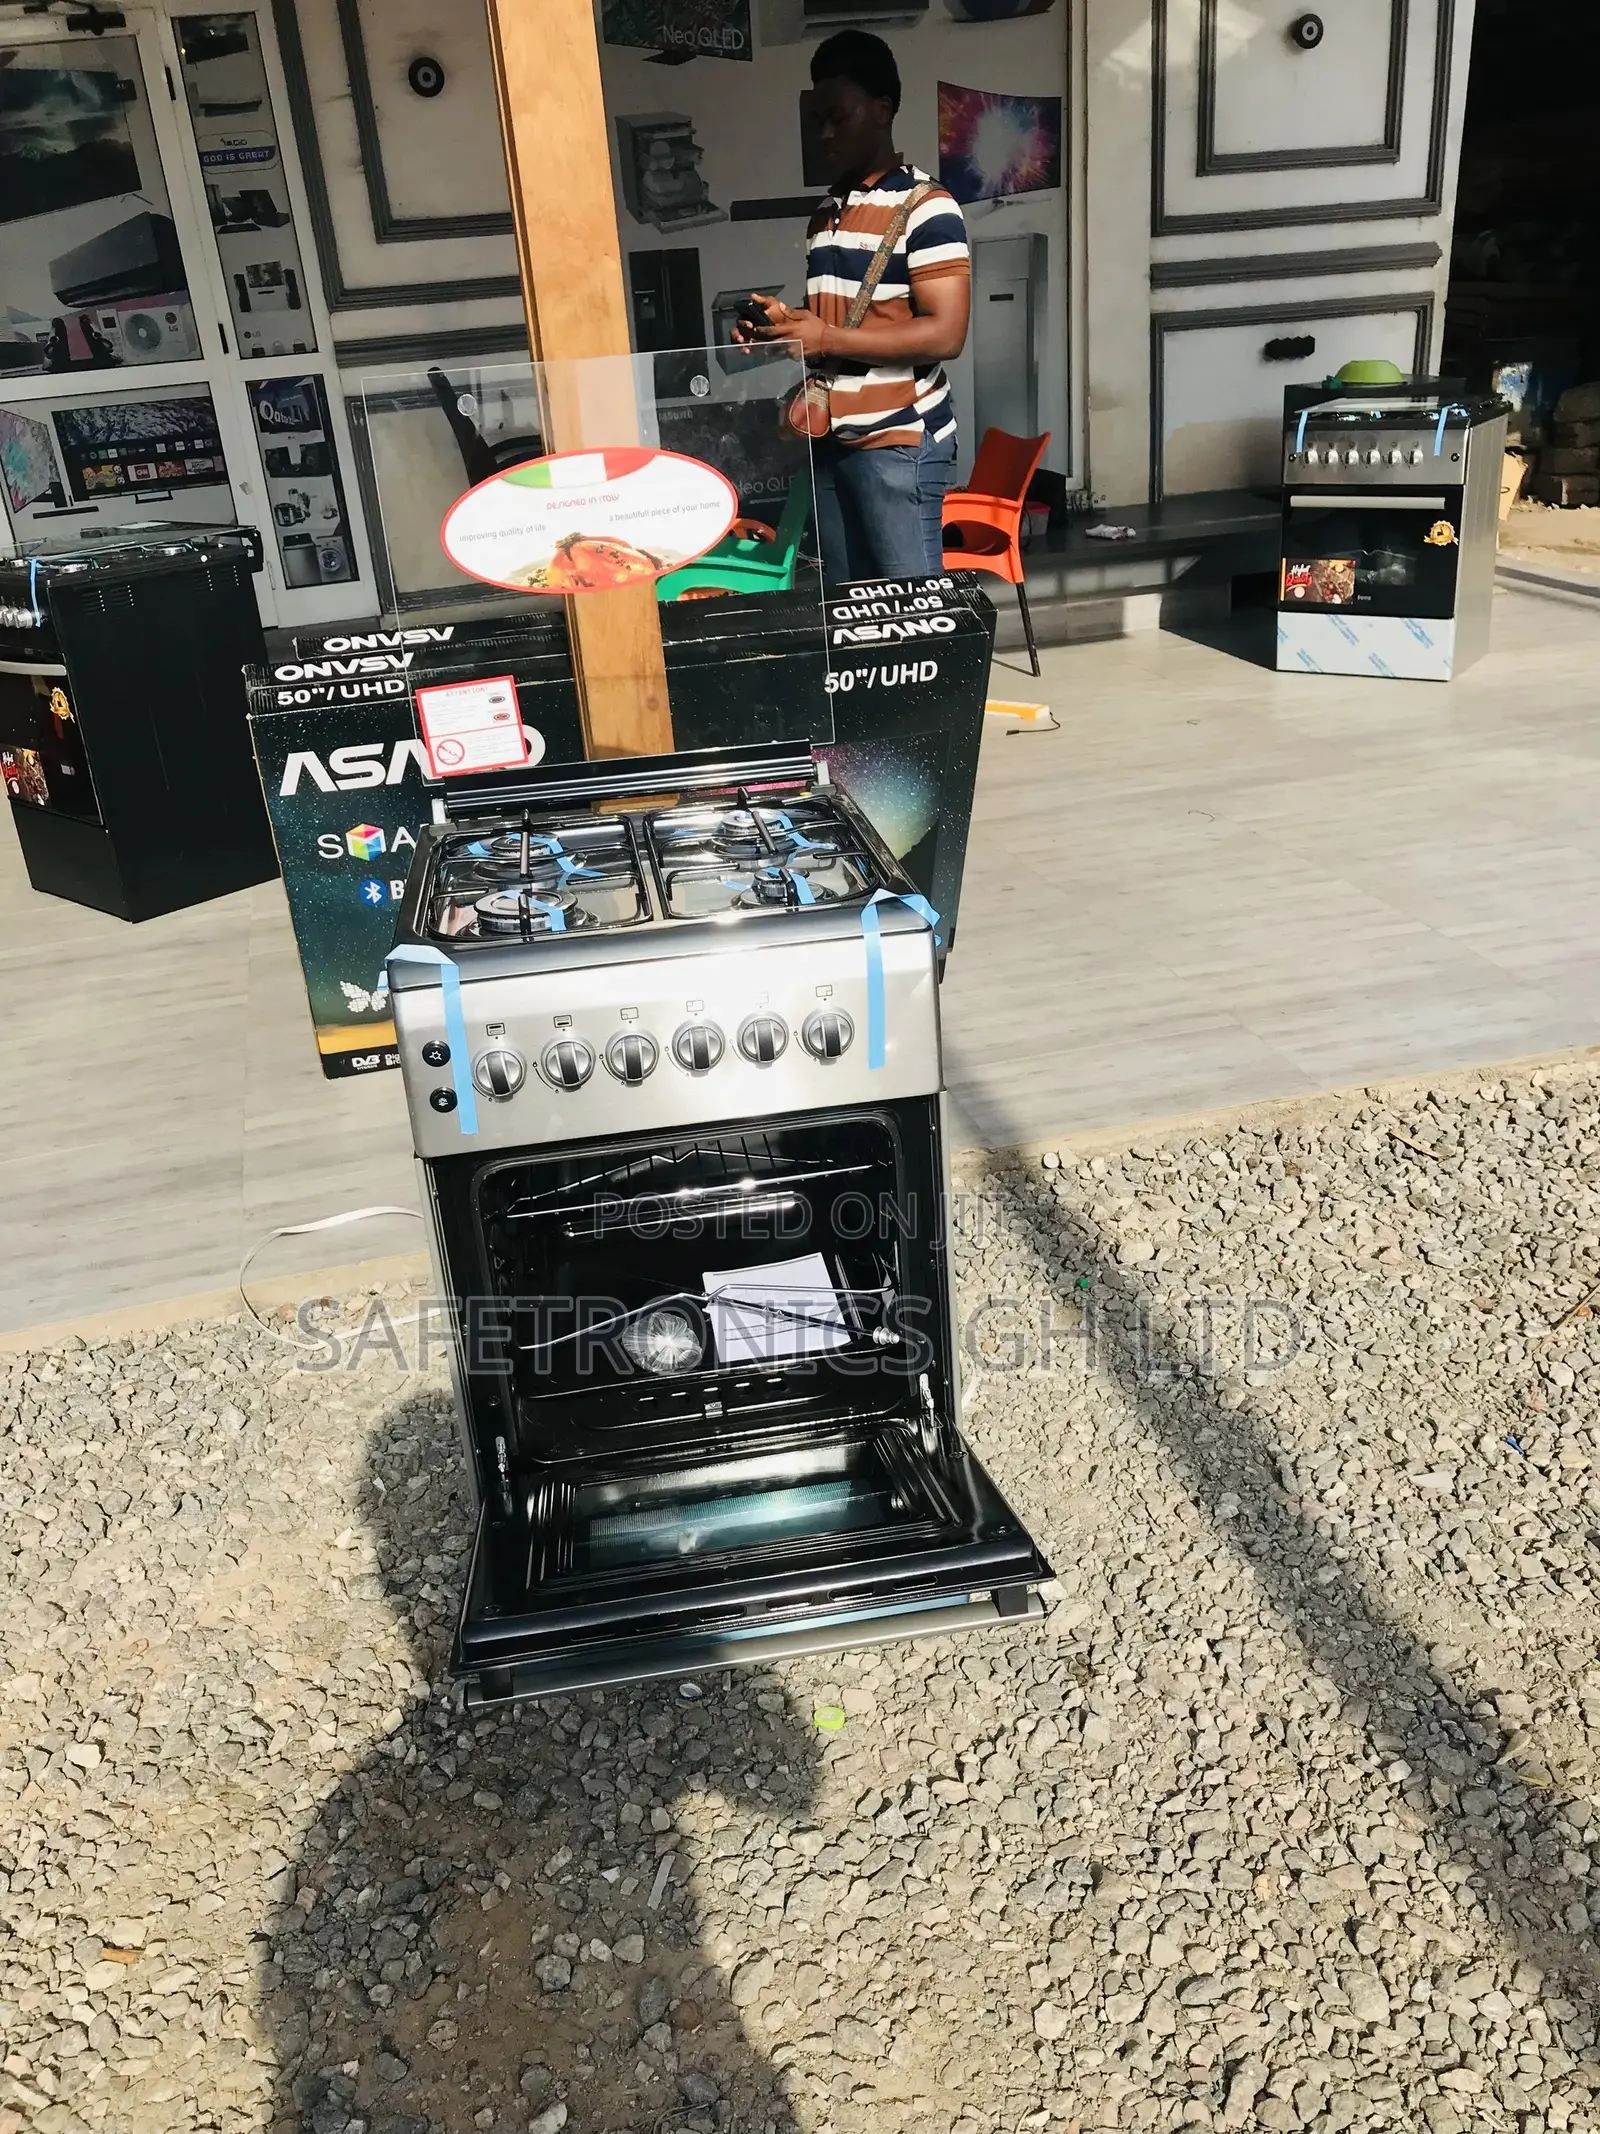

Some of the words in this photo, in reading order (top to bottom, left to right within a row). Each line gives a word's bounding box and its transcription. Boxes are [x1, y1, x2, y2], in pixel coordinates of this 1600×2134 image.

[662, 24, 695, 46] Neo
[698, 27, 745, 50] QLED
[203, 154, 223, 163] GOD
[239, 150, 270, 160] GREAT
[589, 496, 597, 505] IN
[651, 507, 671, 518] piece
[673, 505, 680, 514] of
[681, 504, 699, 515] your
[700, 501, 721, 511] home
[459, 530, 497, 543] improving
[499, 526, 524, 538] quality
[526, 525, 534, 533] of
[535, 523, 547, 532] life
[833, 616, 957, 645] ASANO
[351, 1054, 381, 1068] DVB
